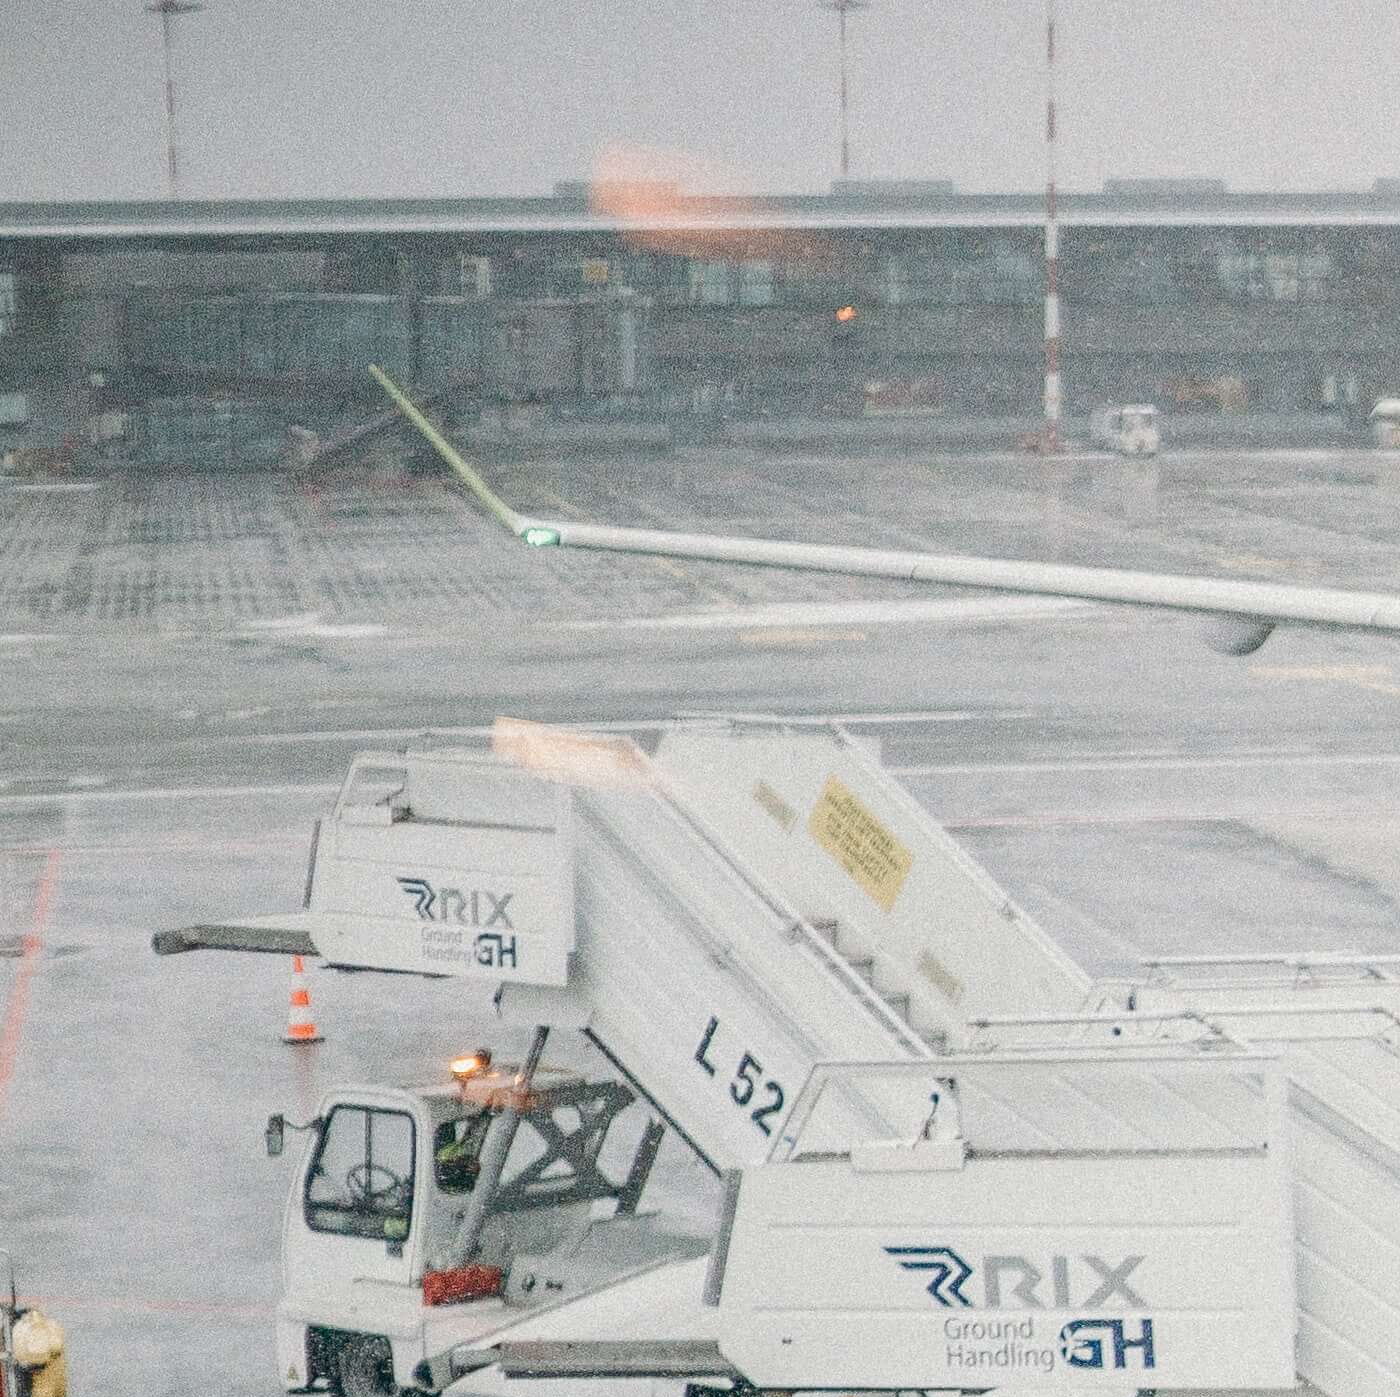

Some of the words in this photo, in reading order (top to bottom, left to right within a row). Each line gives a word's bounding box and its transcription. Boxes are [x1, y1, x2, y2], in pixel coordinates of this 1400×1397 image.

[695, 1016, 718, 1077] L
[730, 1050, 784, 1136] 52
[983, 1255, 1150, 1309] RIX
[944, 1317, 1033, 1341] Ground
[947, 1344, 1055, 1373] Handling
[1060, 1318, 1156, 1369] GH
